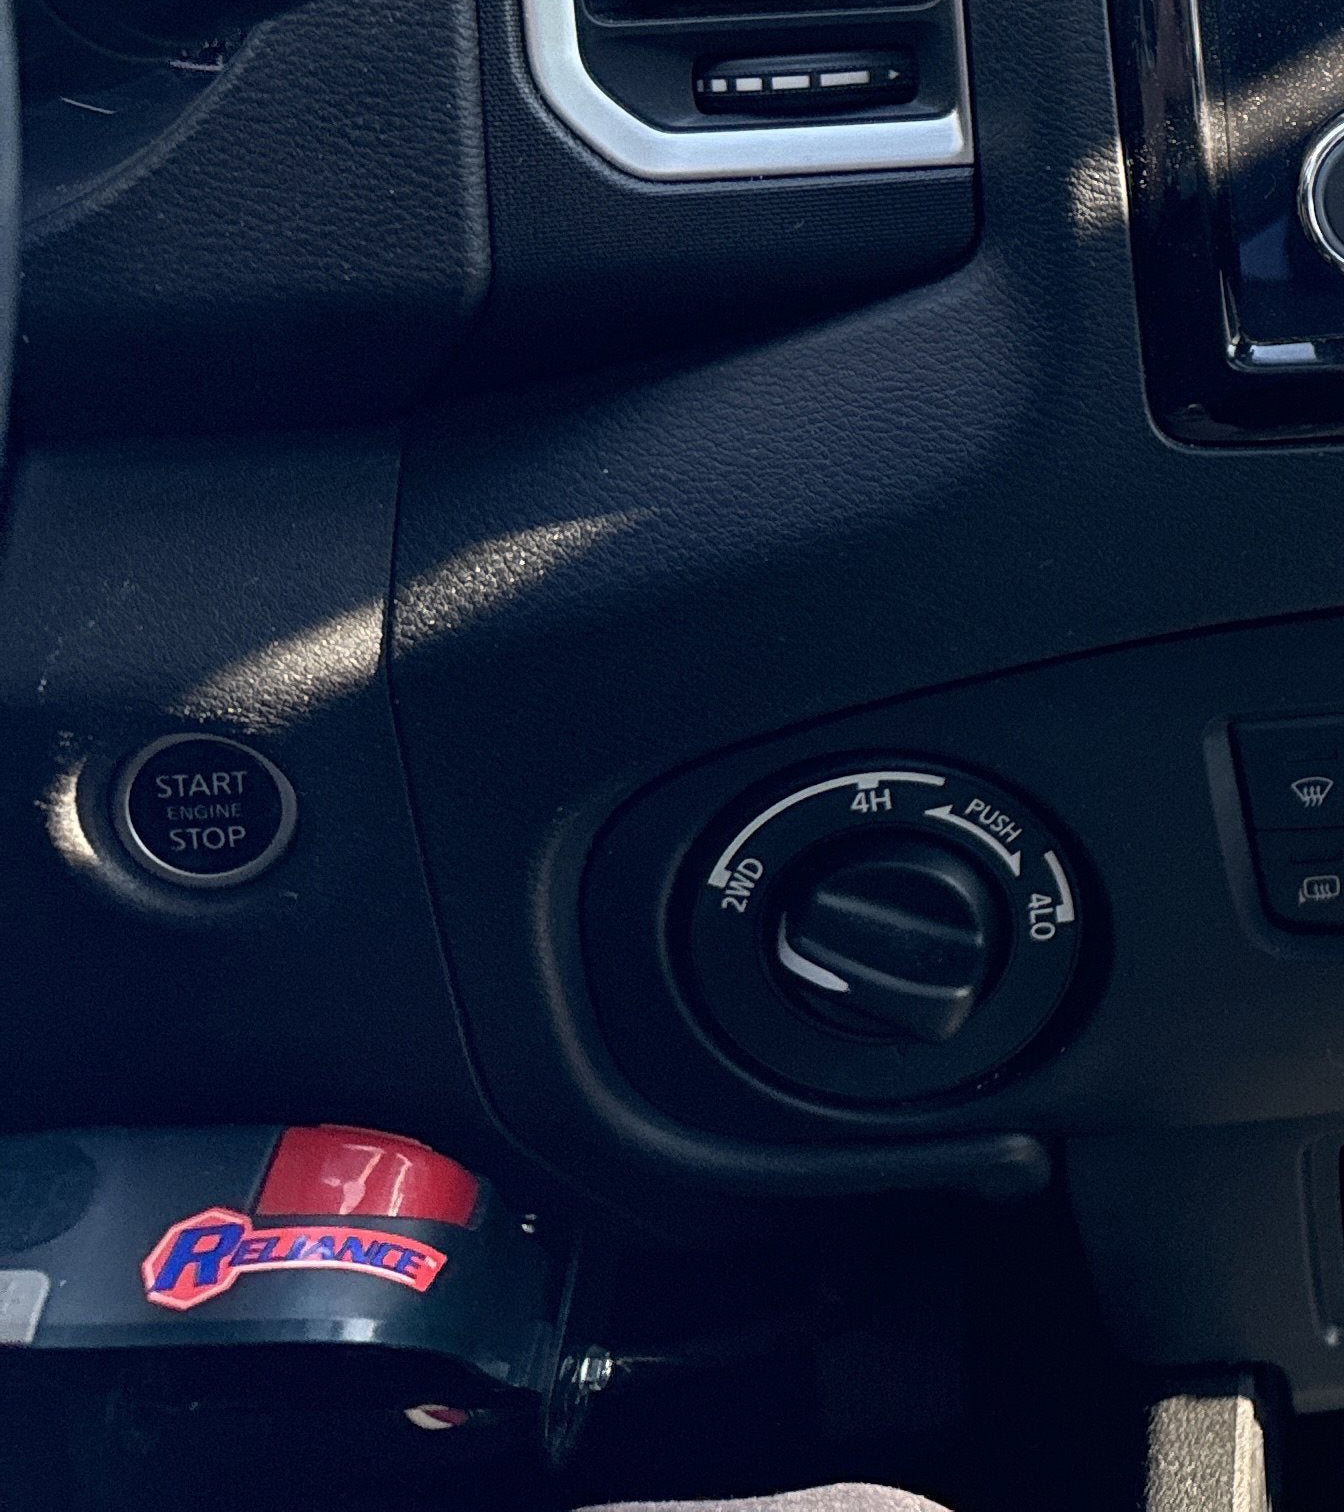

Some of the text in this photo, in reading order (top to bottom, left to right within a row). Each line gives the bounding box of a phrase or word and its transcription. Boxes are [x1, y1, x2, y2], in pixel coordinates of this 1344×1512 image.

[156, 771, 247, 799] START
[850, 787, 892, 814] 4H
[167, 802, 241, 820] ENGINE
[964, 798, 1022, 844] PUSH
[170, 826, 246, 852] STOP
[721, 856, 764, 913] 2WD
[1028, 892, 1057, 942] 4LO
[149, 1222, 427, 1293] RELIANCE
